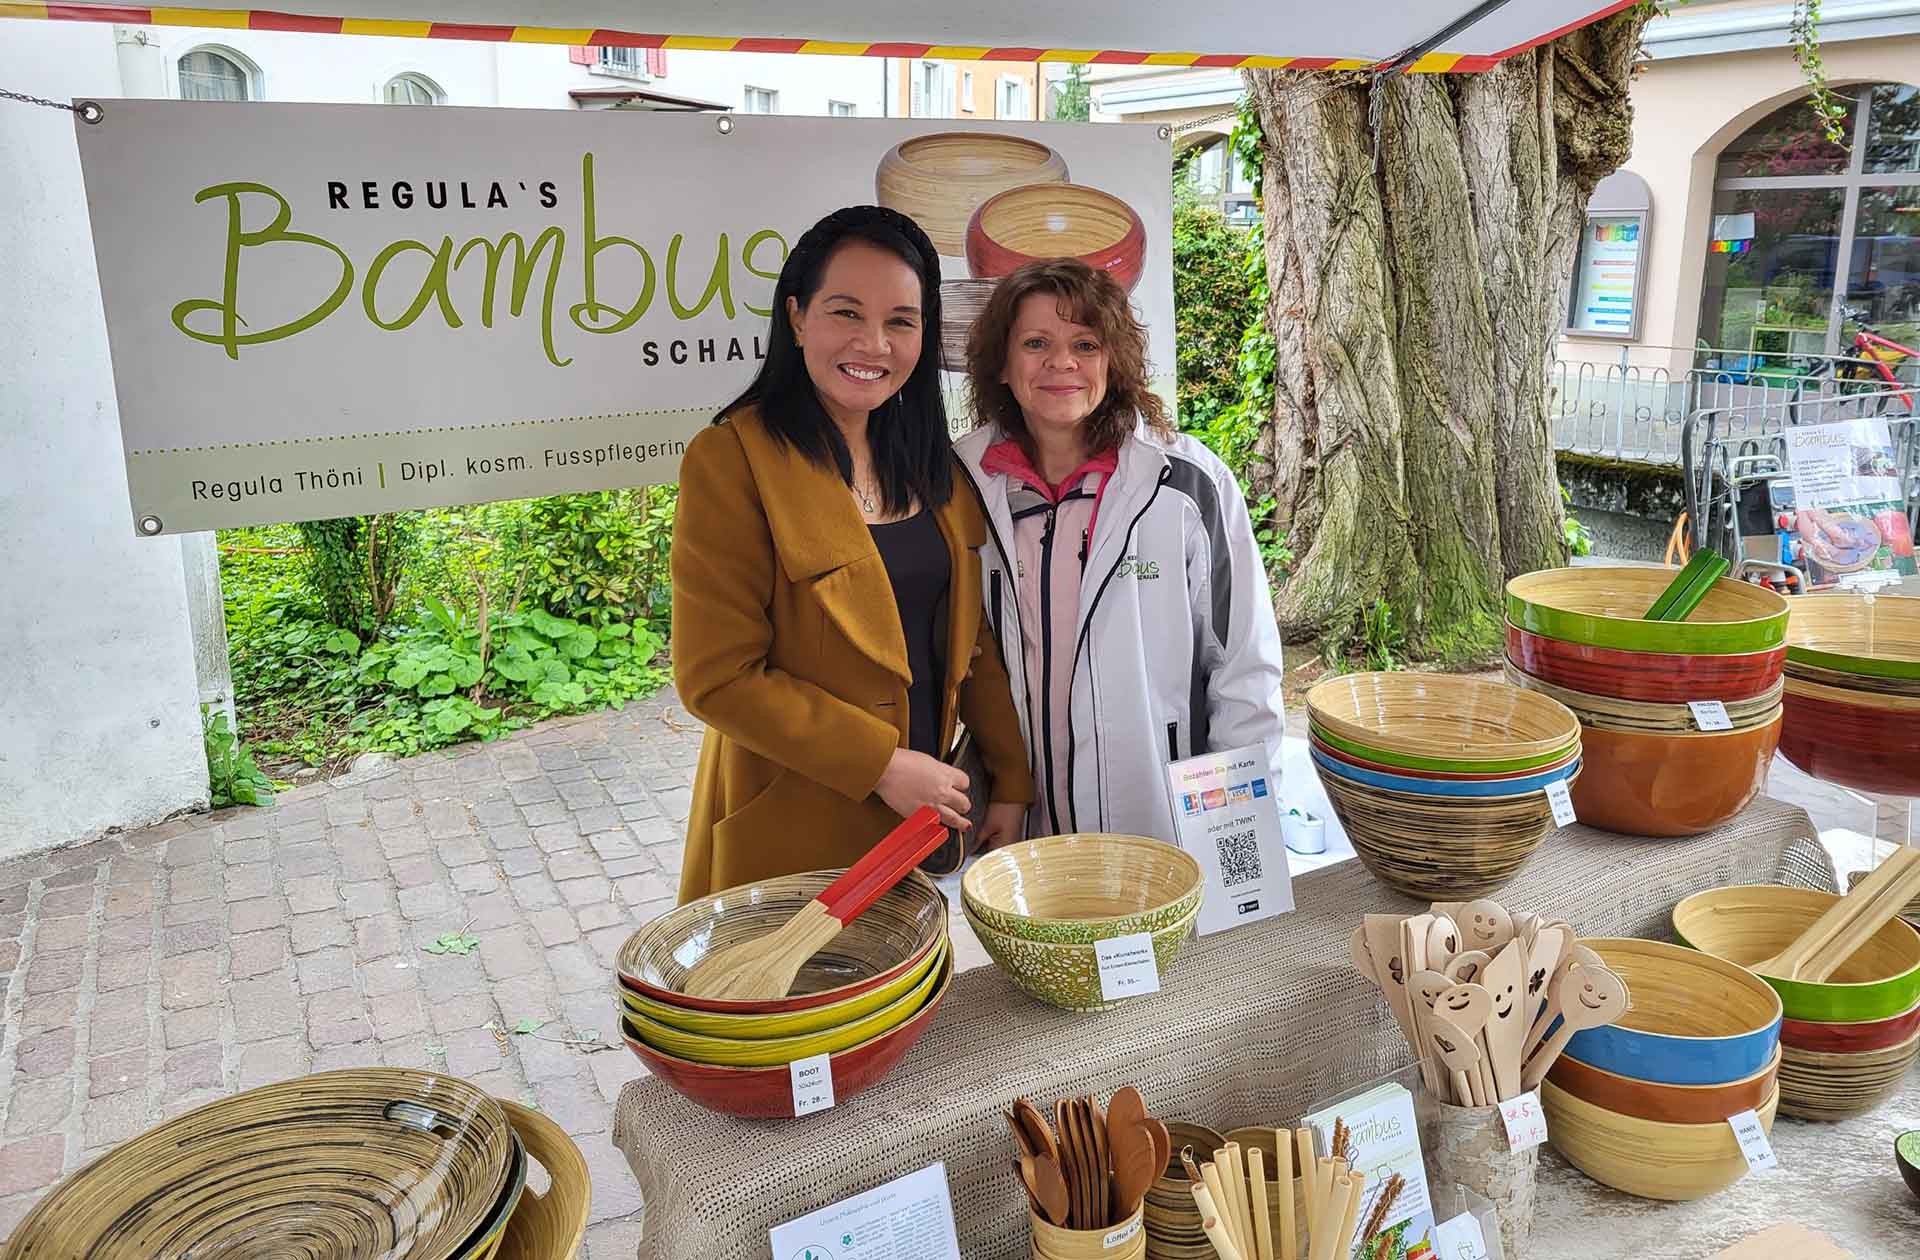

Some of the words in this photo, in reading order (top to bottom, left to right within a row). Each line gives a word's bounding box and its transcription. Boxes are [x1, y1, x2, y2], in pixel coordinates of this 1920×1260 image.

[171, 152, 790, 367] Bambus
[642, 337, 766, 367] SCHAL
[192, 475, 283, 502] Regula
[295, 467, 363, 491] Thöni
[400, 459, 454, 483] Dipl.
[467, 455, 534, 476] kosm.
[544, 439, 685, 467] Fusspflegerin
[1239, 760, 1256, 769] Karte
[1207, 823, 1223, 833] oder
[1224, 820, 1235, 830] mit
[1235, 815, 1257, 826] TWINT
[799, 1066, 819, 1078] BOOT
